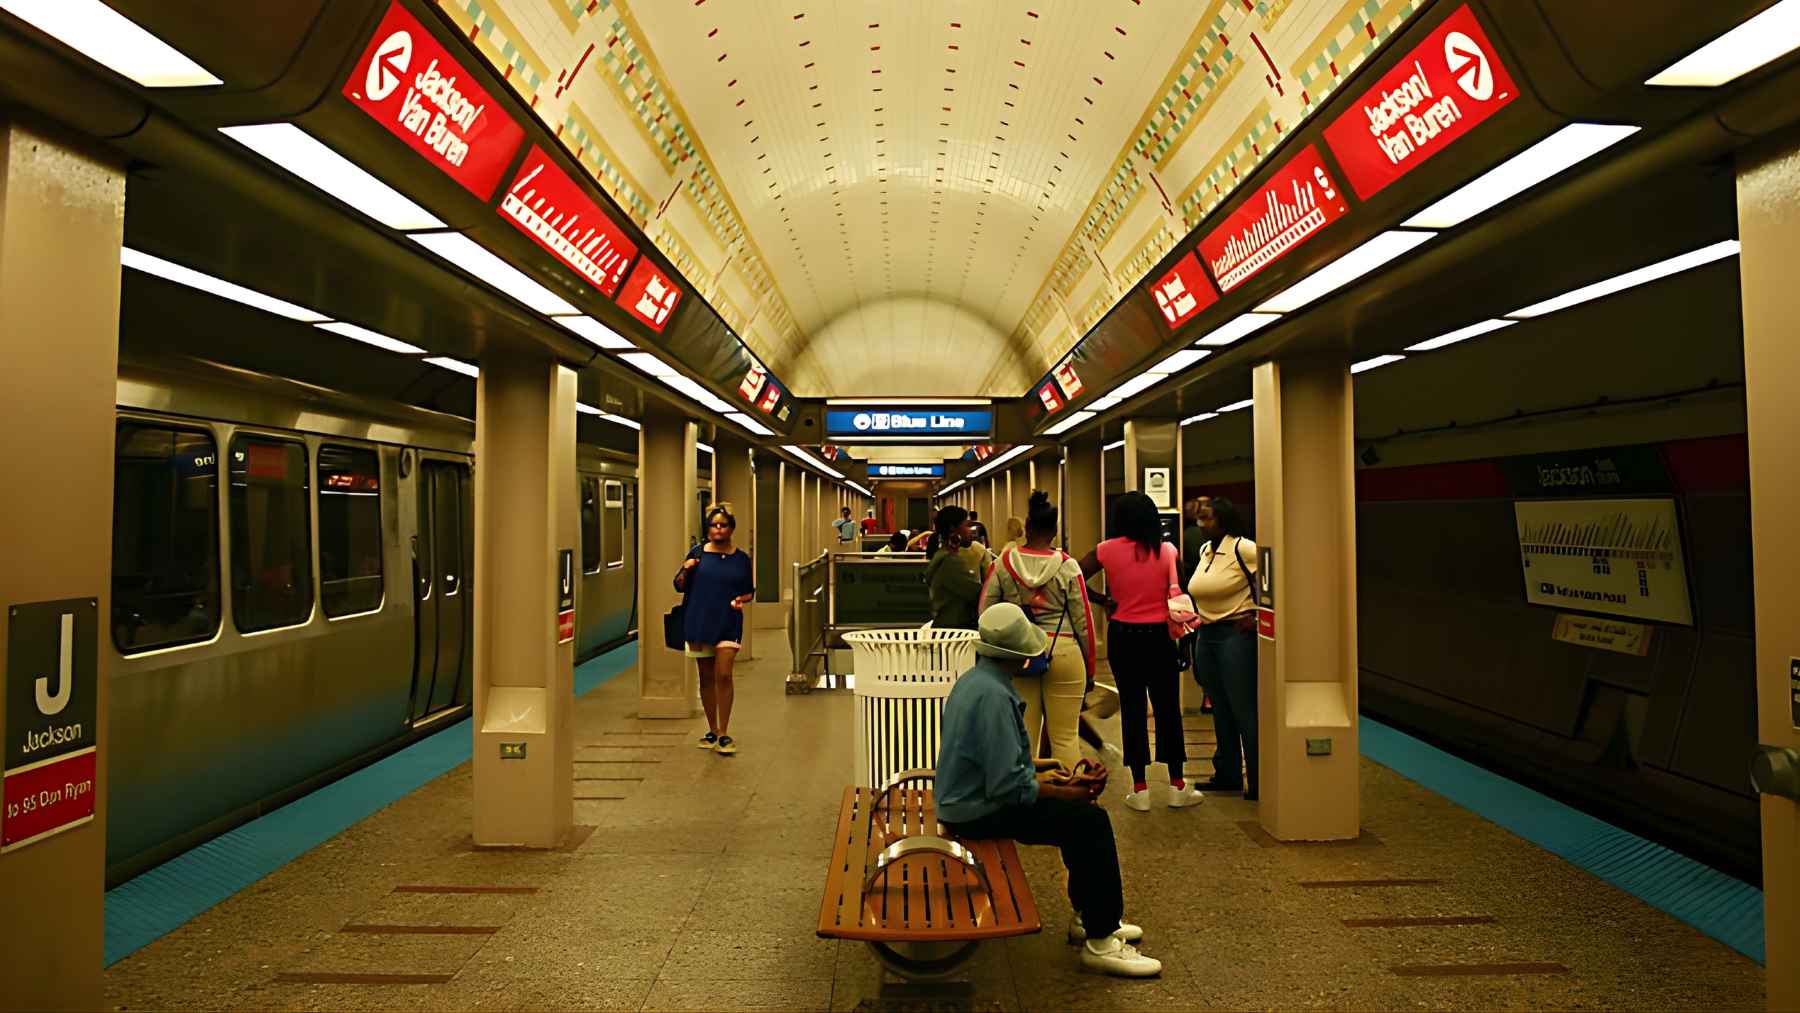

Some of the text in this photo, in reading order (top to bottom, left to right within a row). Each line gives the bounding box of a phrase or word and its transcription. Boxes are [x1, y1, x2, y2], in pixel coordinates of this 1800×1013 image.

[398, 87, 469, 167] Van Buren
[1377, 95, 1462, 164] Van Buren
[891, 414, 964, 428] Blue Line
[563, 553, 570, 594] J
[1262, 551, 1269, 592] J
[35, 613, 73, 716] J
[23, 723, 82, 753] Jackson
